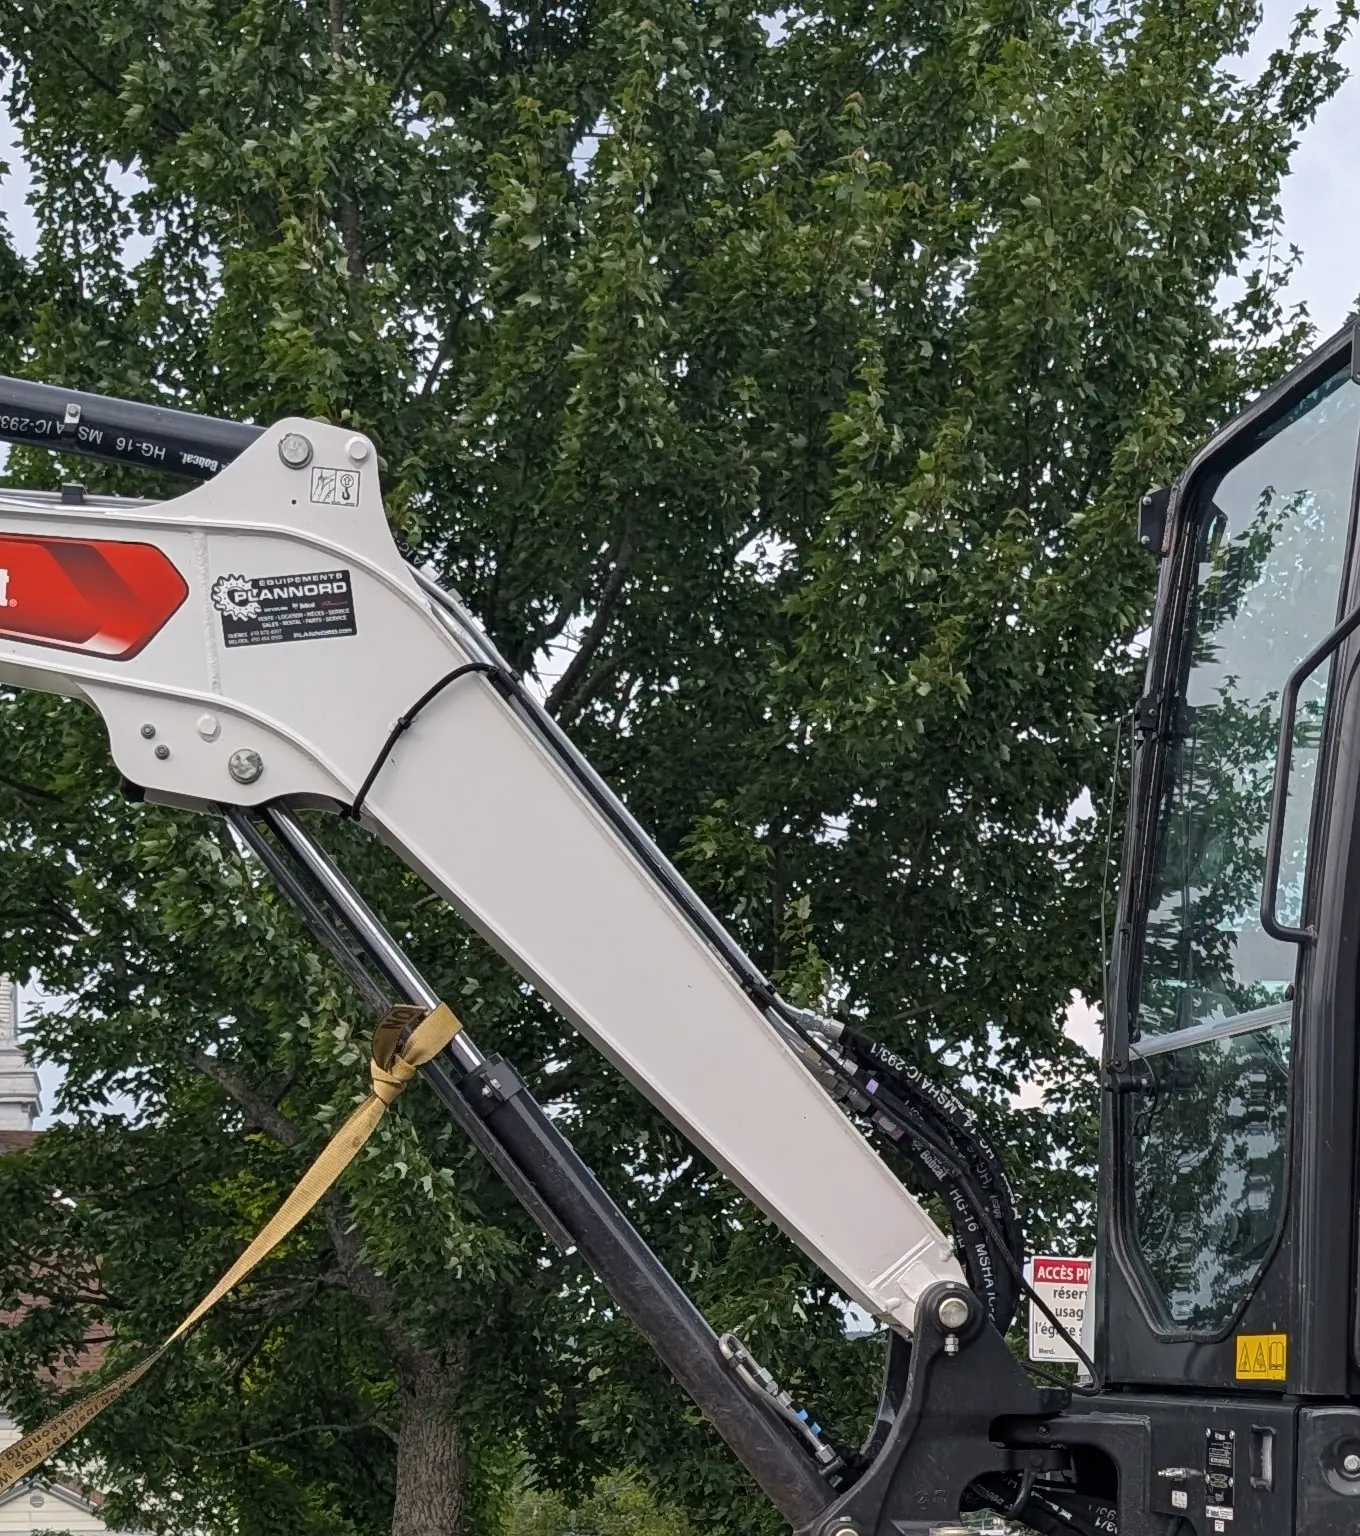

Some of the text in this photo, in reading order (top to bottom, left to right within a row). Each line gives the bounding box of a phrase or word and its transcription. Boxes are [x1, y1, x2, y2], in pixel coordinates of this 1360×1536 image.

[116, 437, 166, 461] HG-16
[234, 581, 347, 604] PLANNORD
[947, 1186, 981, 1233] HG-16
[975, 1242, 993, 1289] MSHA
[1038, 1264, 1074, 1280] ACCÈS
[13, 1448, 42, 1471] kgs
